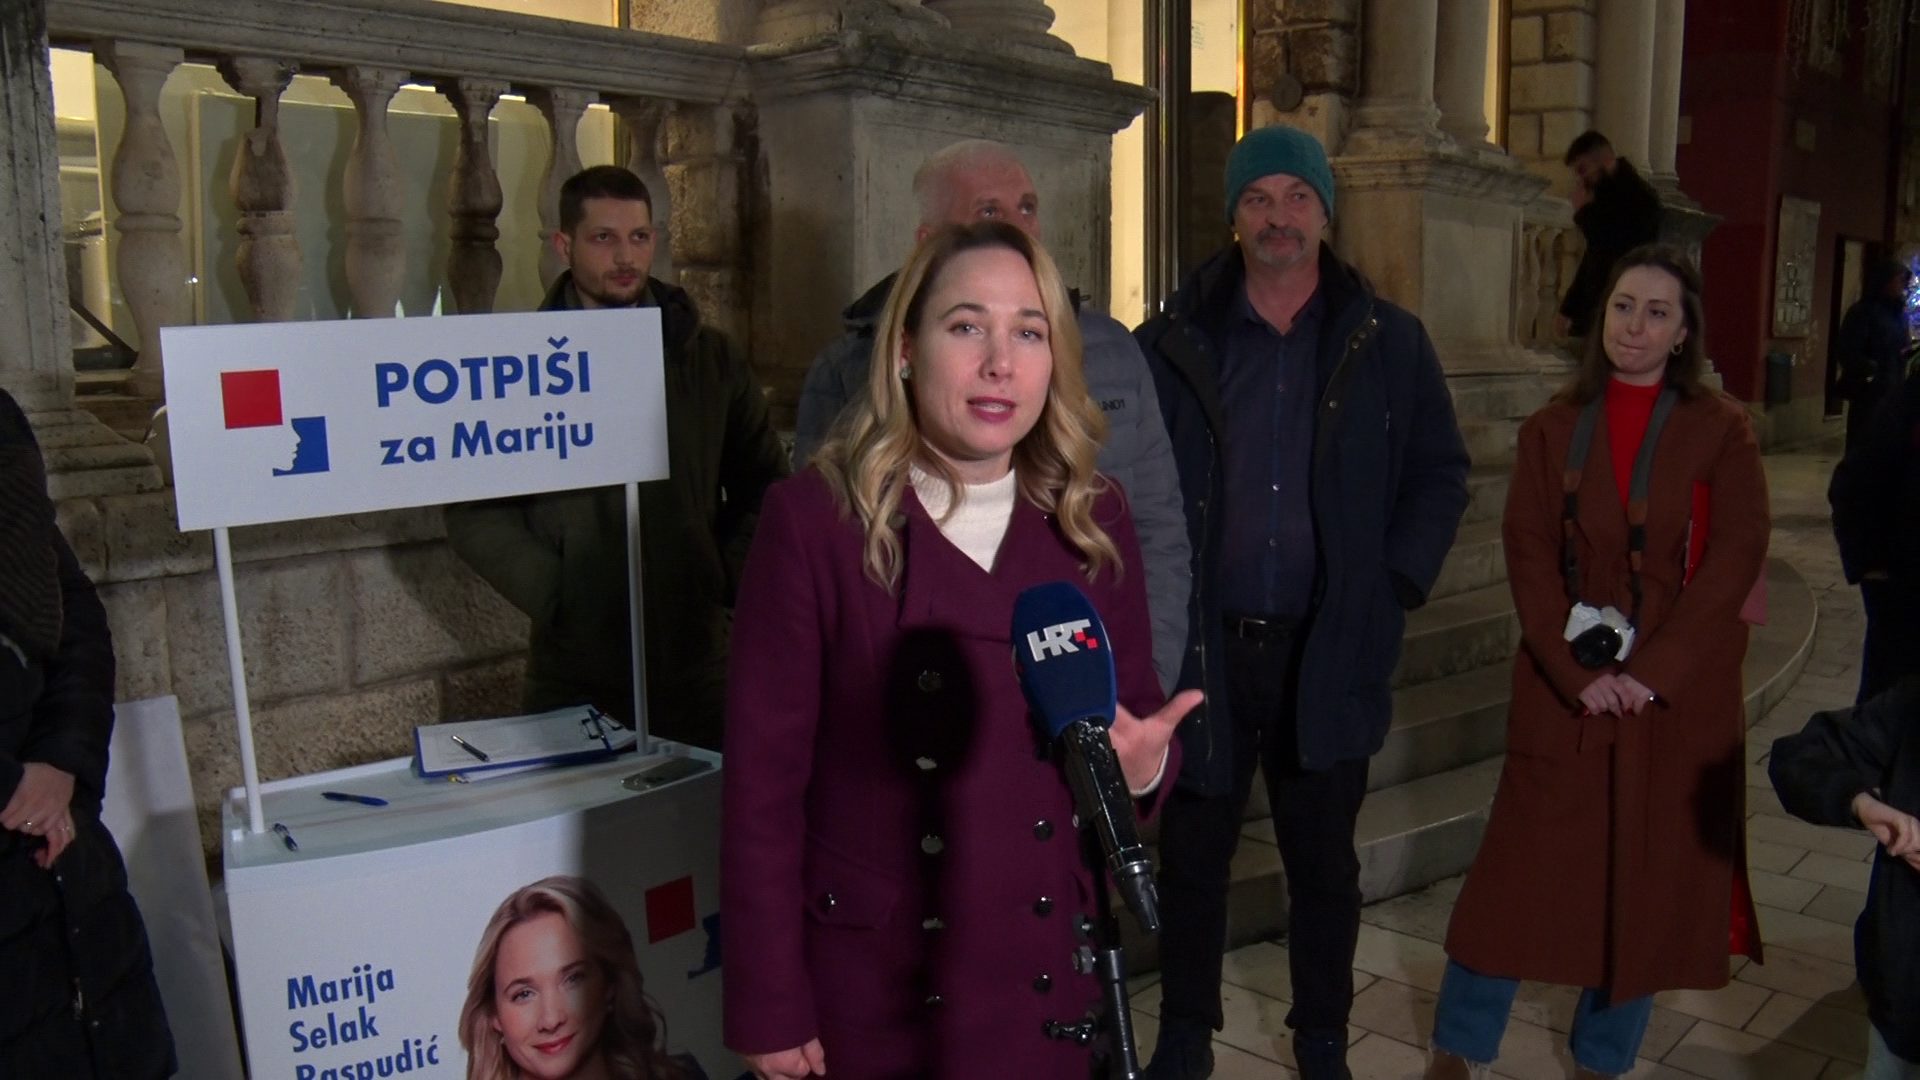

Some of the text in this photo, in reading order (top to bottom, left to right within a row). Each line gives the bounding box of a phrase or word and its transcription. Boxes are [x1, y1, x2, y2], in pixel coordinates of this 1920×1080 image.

[375, 336, 591, 408] POTPIŠI
[381, 411, 594, 466] za Mariju
[1026, 618, 1098, 662] HRT
[287, 963, 396, 1010] Marija
[289, 1005, 380, 1053] Selak
